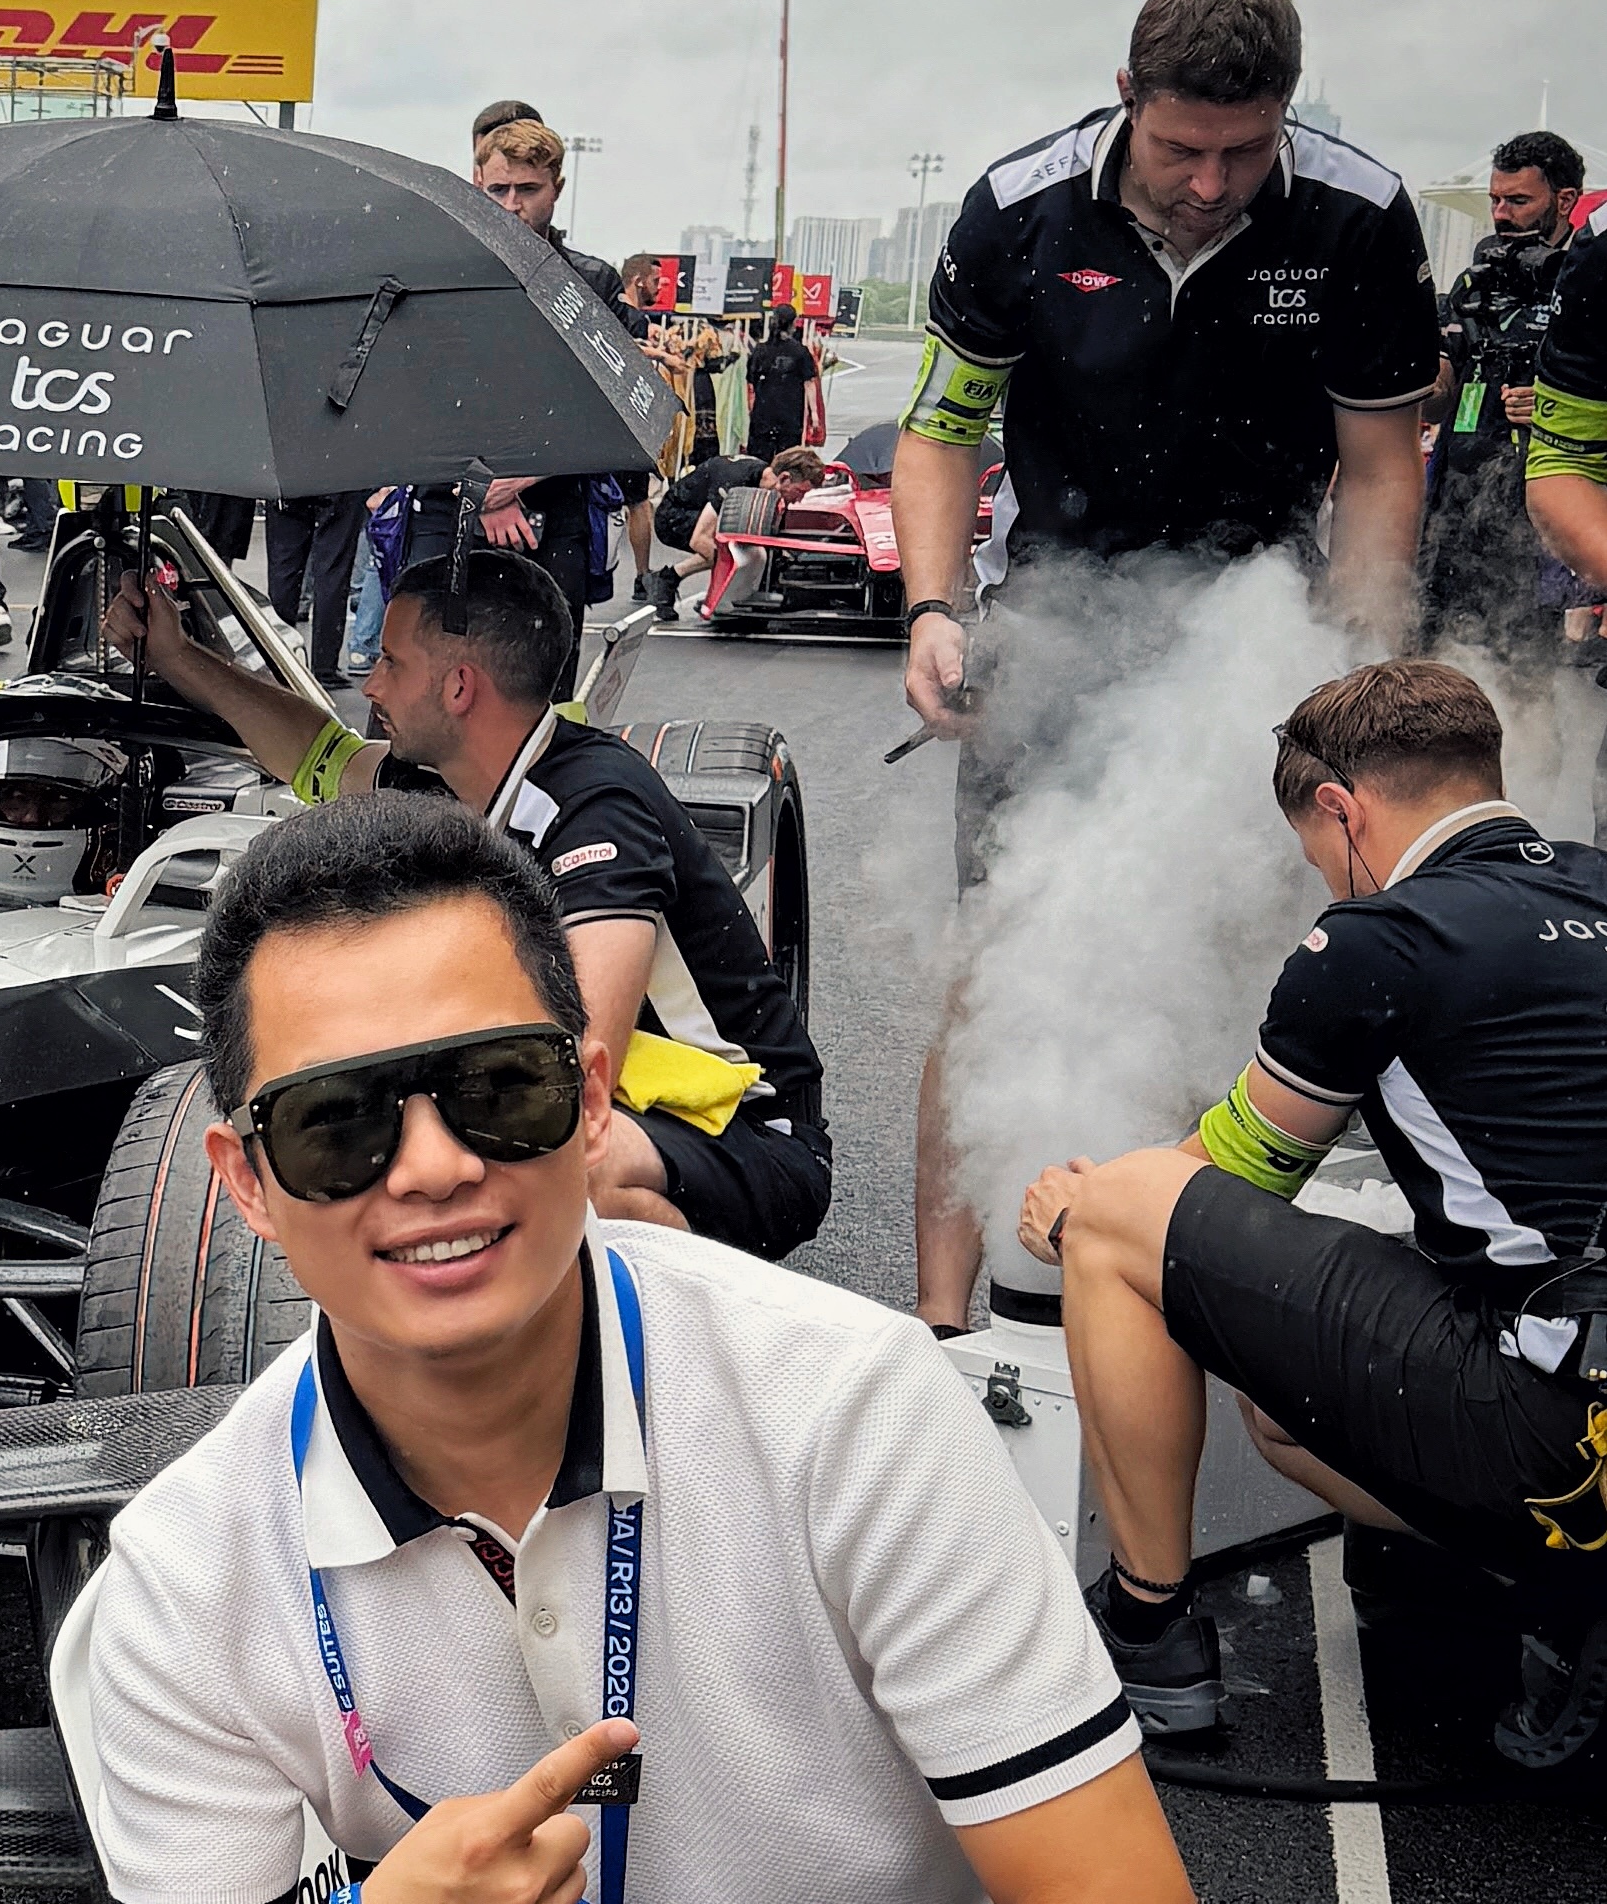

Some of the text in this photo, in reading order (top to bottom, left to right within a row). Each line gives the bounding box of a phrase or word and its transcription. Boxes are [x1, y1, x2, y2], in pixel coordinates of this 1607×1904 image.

[1268, 285, 1307, 308] tcs
[11, 355, 115, 415] tcs
[562, 845, 613, 868] Castrol
